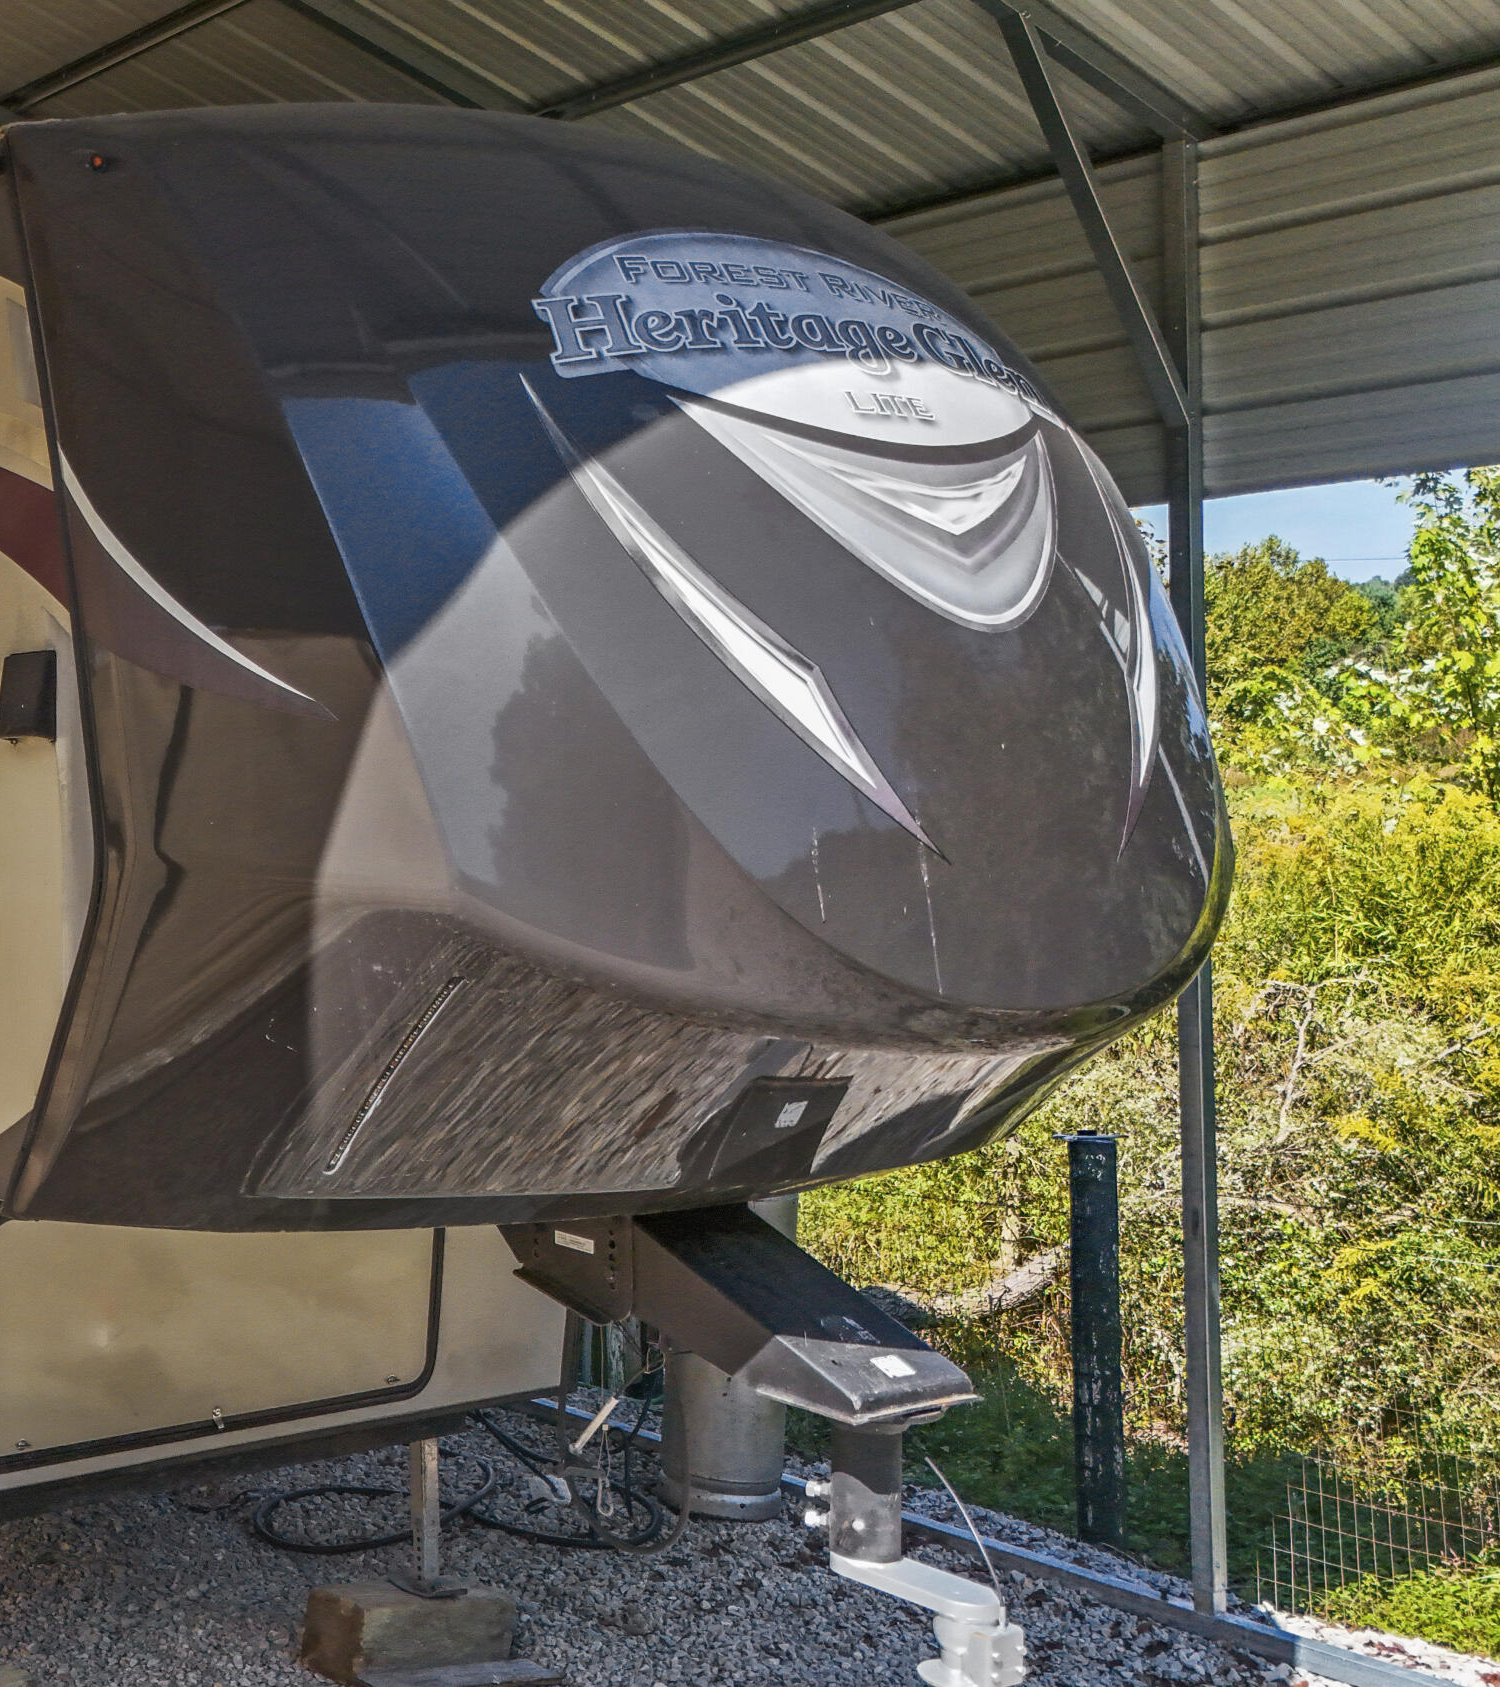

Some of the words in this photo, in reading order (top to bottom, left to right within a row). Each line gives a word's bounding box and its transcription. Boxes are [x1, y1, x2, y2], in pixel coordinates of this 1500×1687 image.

[613, 254, 811, 292] FOREST
[819, 271, 940, 320] RIVER
[531, 292, 920, 376] Heritage
[911, 322, 1053, 416] Glen
[842, 389, 937, 422] LITE
